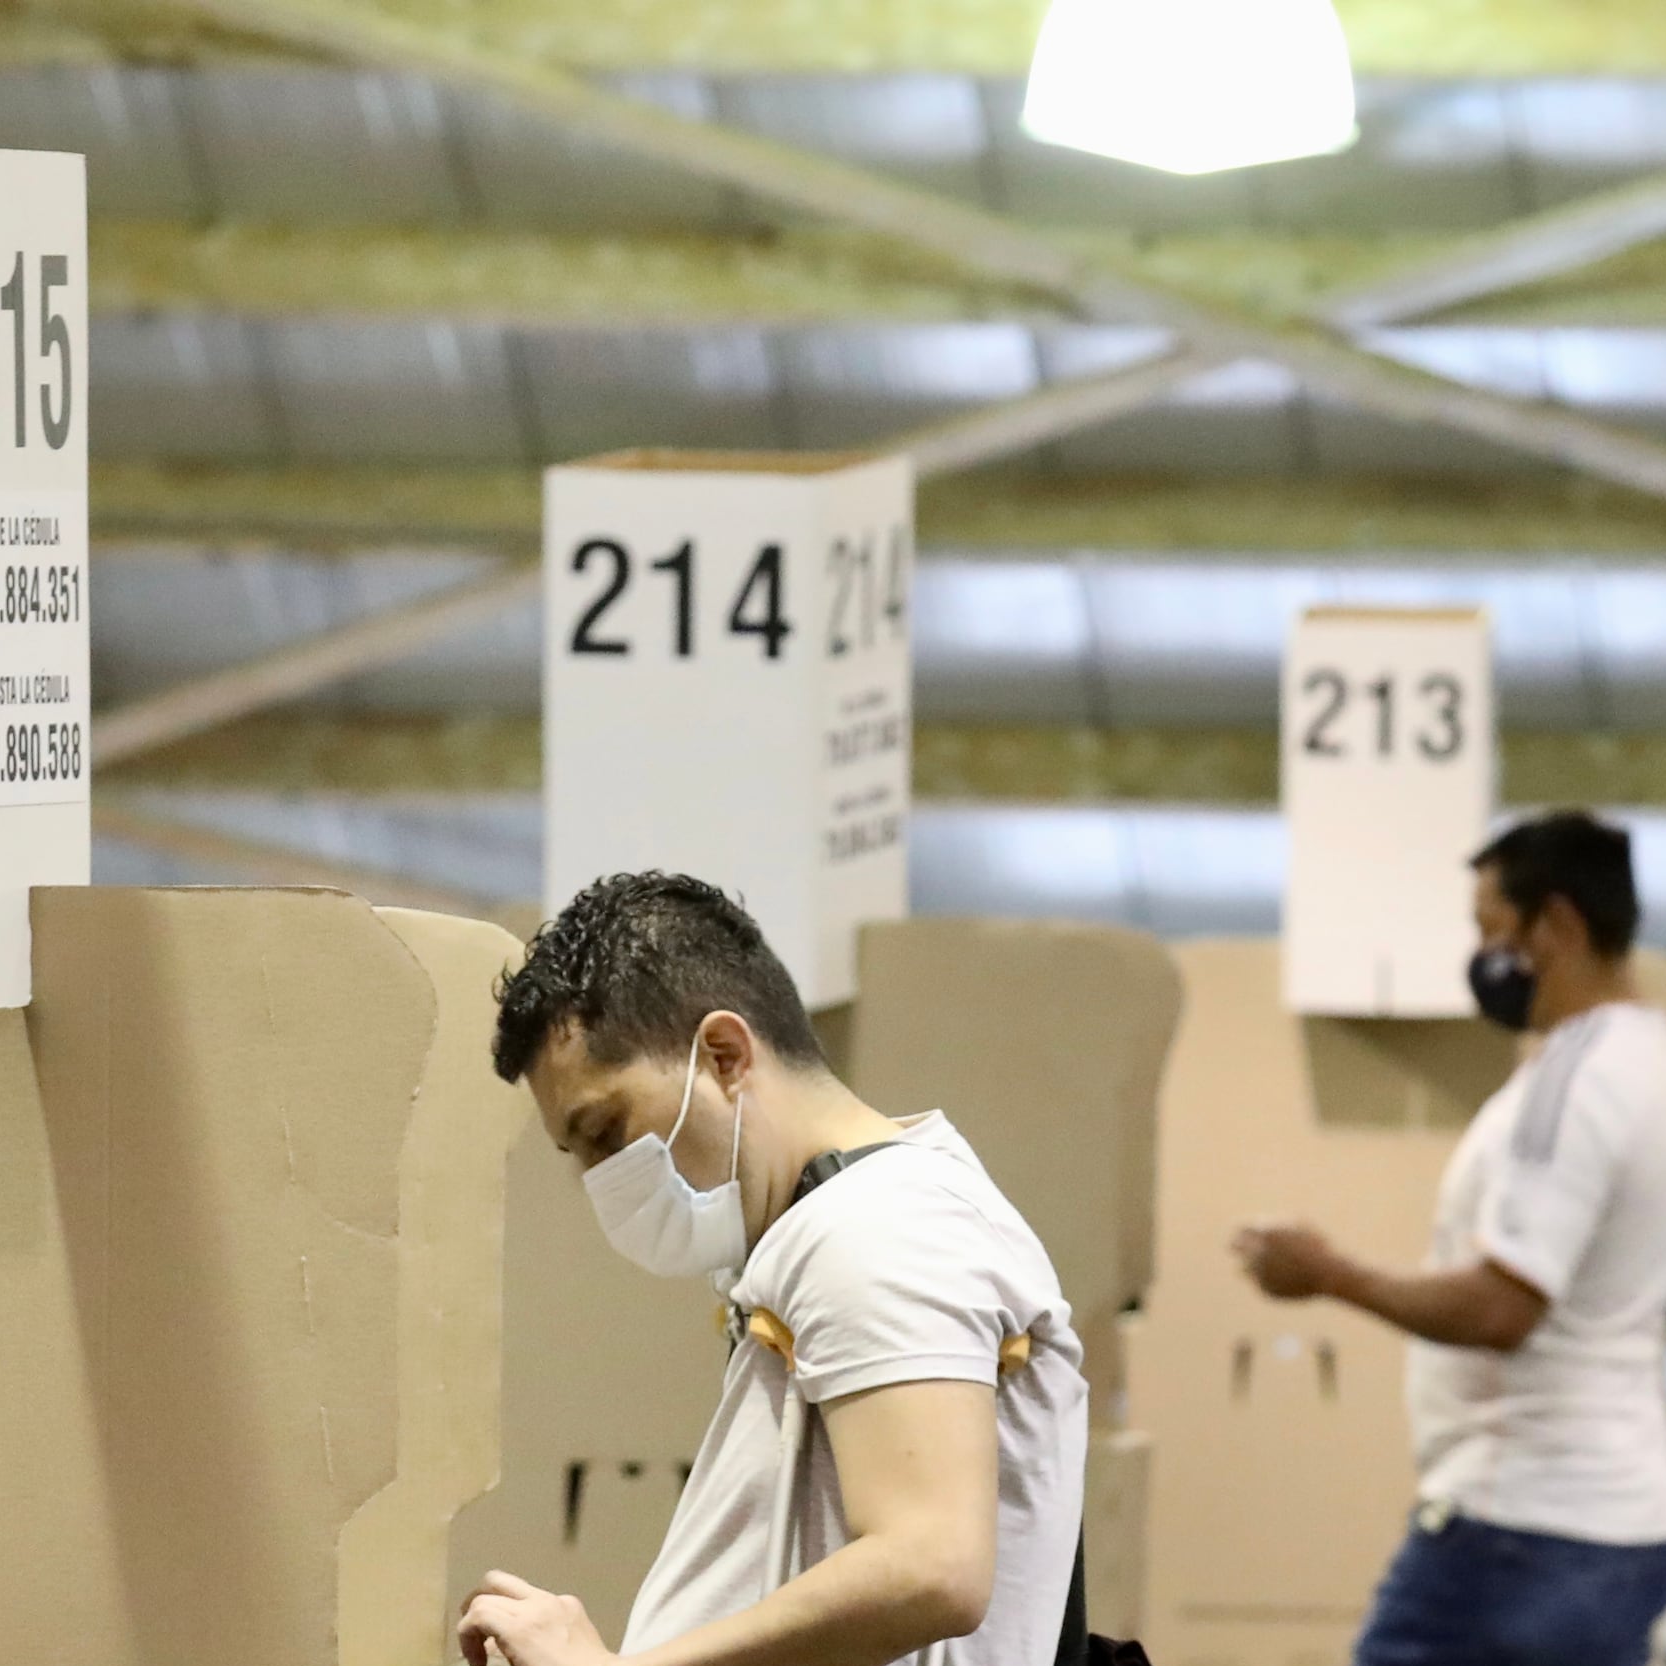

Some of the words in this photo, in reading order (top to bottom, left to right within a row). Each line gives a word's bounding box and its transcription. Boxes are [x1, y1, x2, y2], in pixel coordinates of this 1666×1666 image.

[8, 516, 21, 545] LA
[569, 537, 792, 659] 214
[19, 675, 31, 704] LA
[1303, 667, 1463, 762] 213
